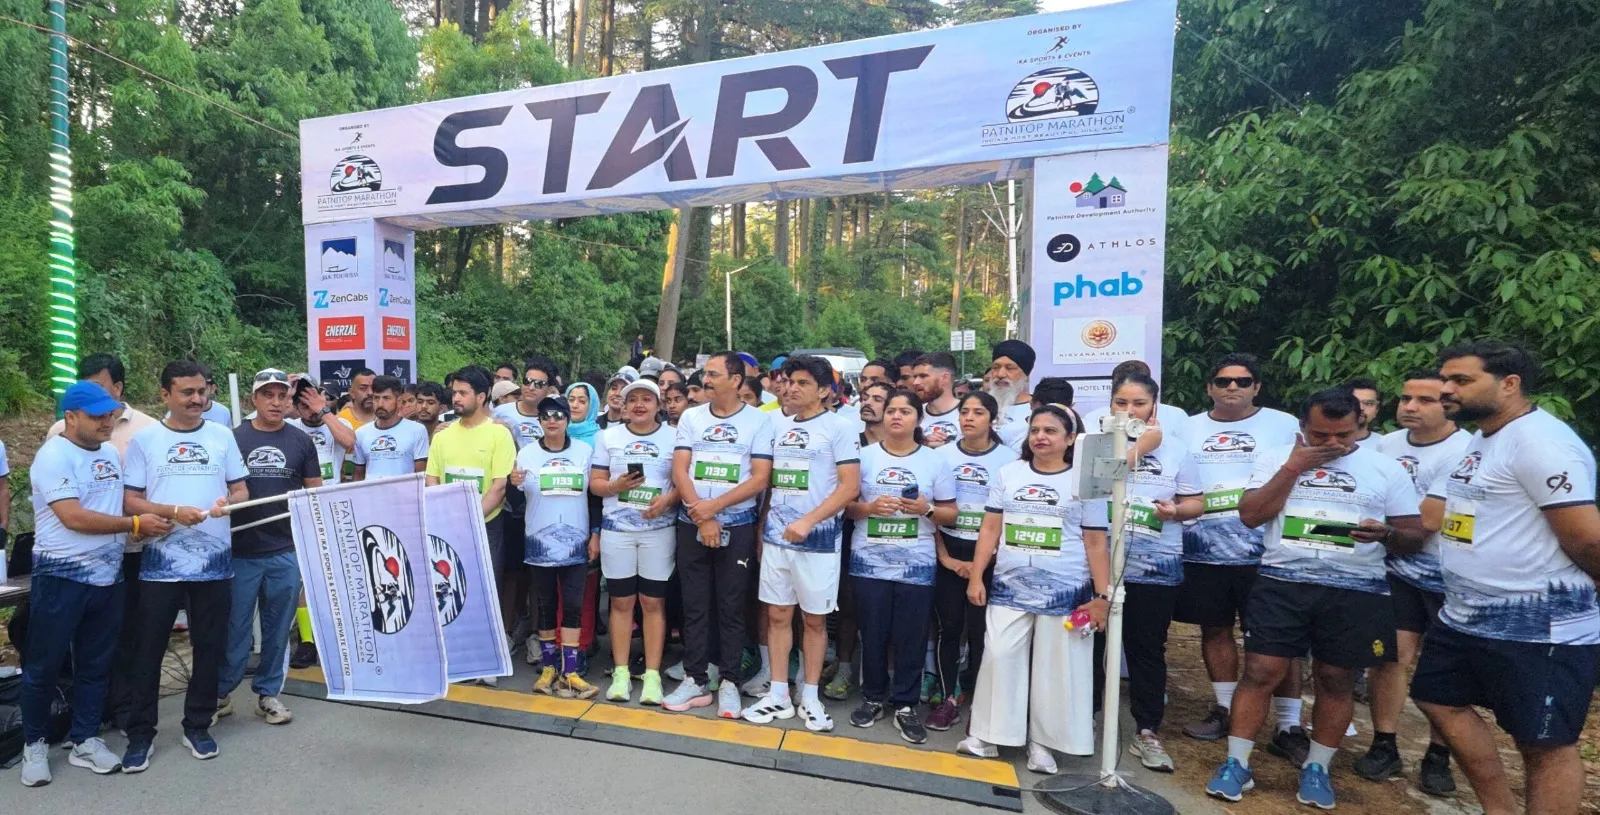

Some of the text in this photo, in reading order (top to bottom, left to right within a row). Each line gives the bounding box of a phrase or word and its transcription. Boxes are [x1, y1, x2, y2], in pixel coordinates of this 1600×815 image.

[1028, 25, 1070, 36] ORGANISED
[1030, 55, 1056, 63] SPORTS
[426, 44, 937, 204] START
[982, 114, 1125, 138] PATNITOP MARATHON
[318, 196, 352, 205] PATNITOP
[354, 192, 397, 201] MARATHON
[1076, 210, 1121, 219] Development
[1088, 238, 1156, 250] ATHLOS
[1054, 272, 1143, 306] phab
[331, 293, 369, 303] ZenCabs
[390, 294, 411, 305] ZenCabs
[325, 324, 358, 337] ENERZAL
[386, 324, 406, 336] ENERZAL
[705, 466, 728, 476] 1139
[552, 477, 573, 486] 1133
[777, 474, 796, 484] 1154
[628, 490, 653, 500] 1070
[1207, 494, 1238, 507] 1254
[957, 516, 981, 526] 033
[1133, 510, 1149, 522] 74
[878, 522, 906, 533] 1072
[1015, 530, 1046, 542] 1248
[339, 500, 375, 663] PATNITOP MARATHON
[313, 503, 322, 525] EVENT
[319, 528, 325, 536] BY
[323, 553, 332, 580] SPORTS
[330, 589, 340, 616] EVENTS
[336, 617, 346, 646] PRIVATE
[342, 648, 350, 676] LIMITED
